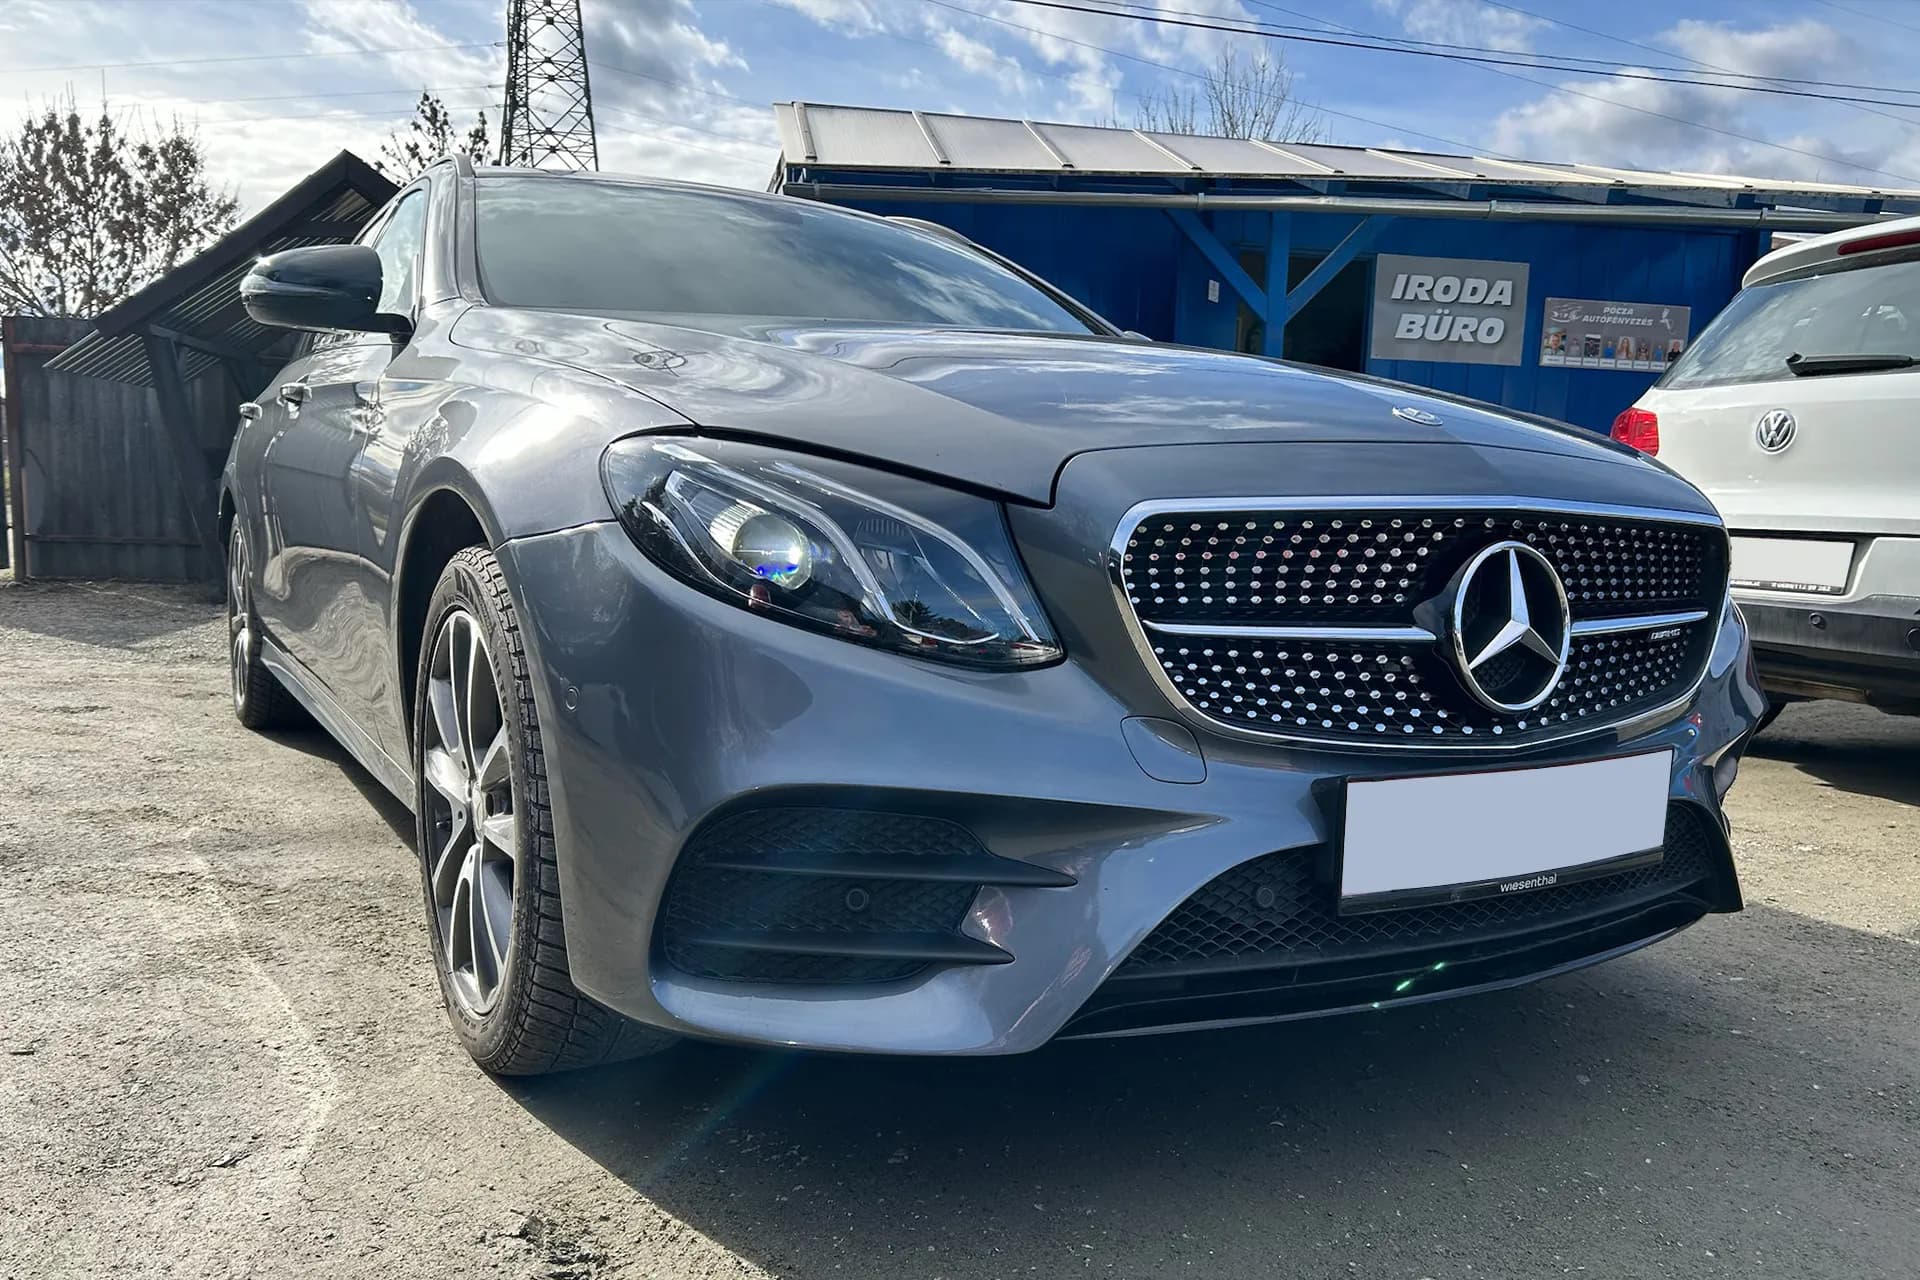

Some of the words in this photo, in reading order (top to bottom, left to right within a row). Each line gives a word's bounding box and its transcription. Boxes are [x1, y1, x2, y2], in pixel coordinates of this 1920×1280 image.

[1391, 273, 1513, 306] IRODA
[1395, 308, 1505, 344] BÜRO
[1501, 873, 1557, 892] wiesenthal
